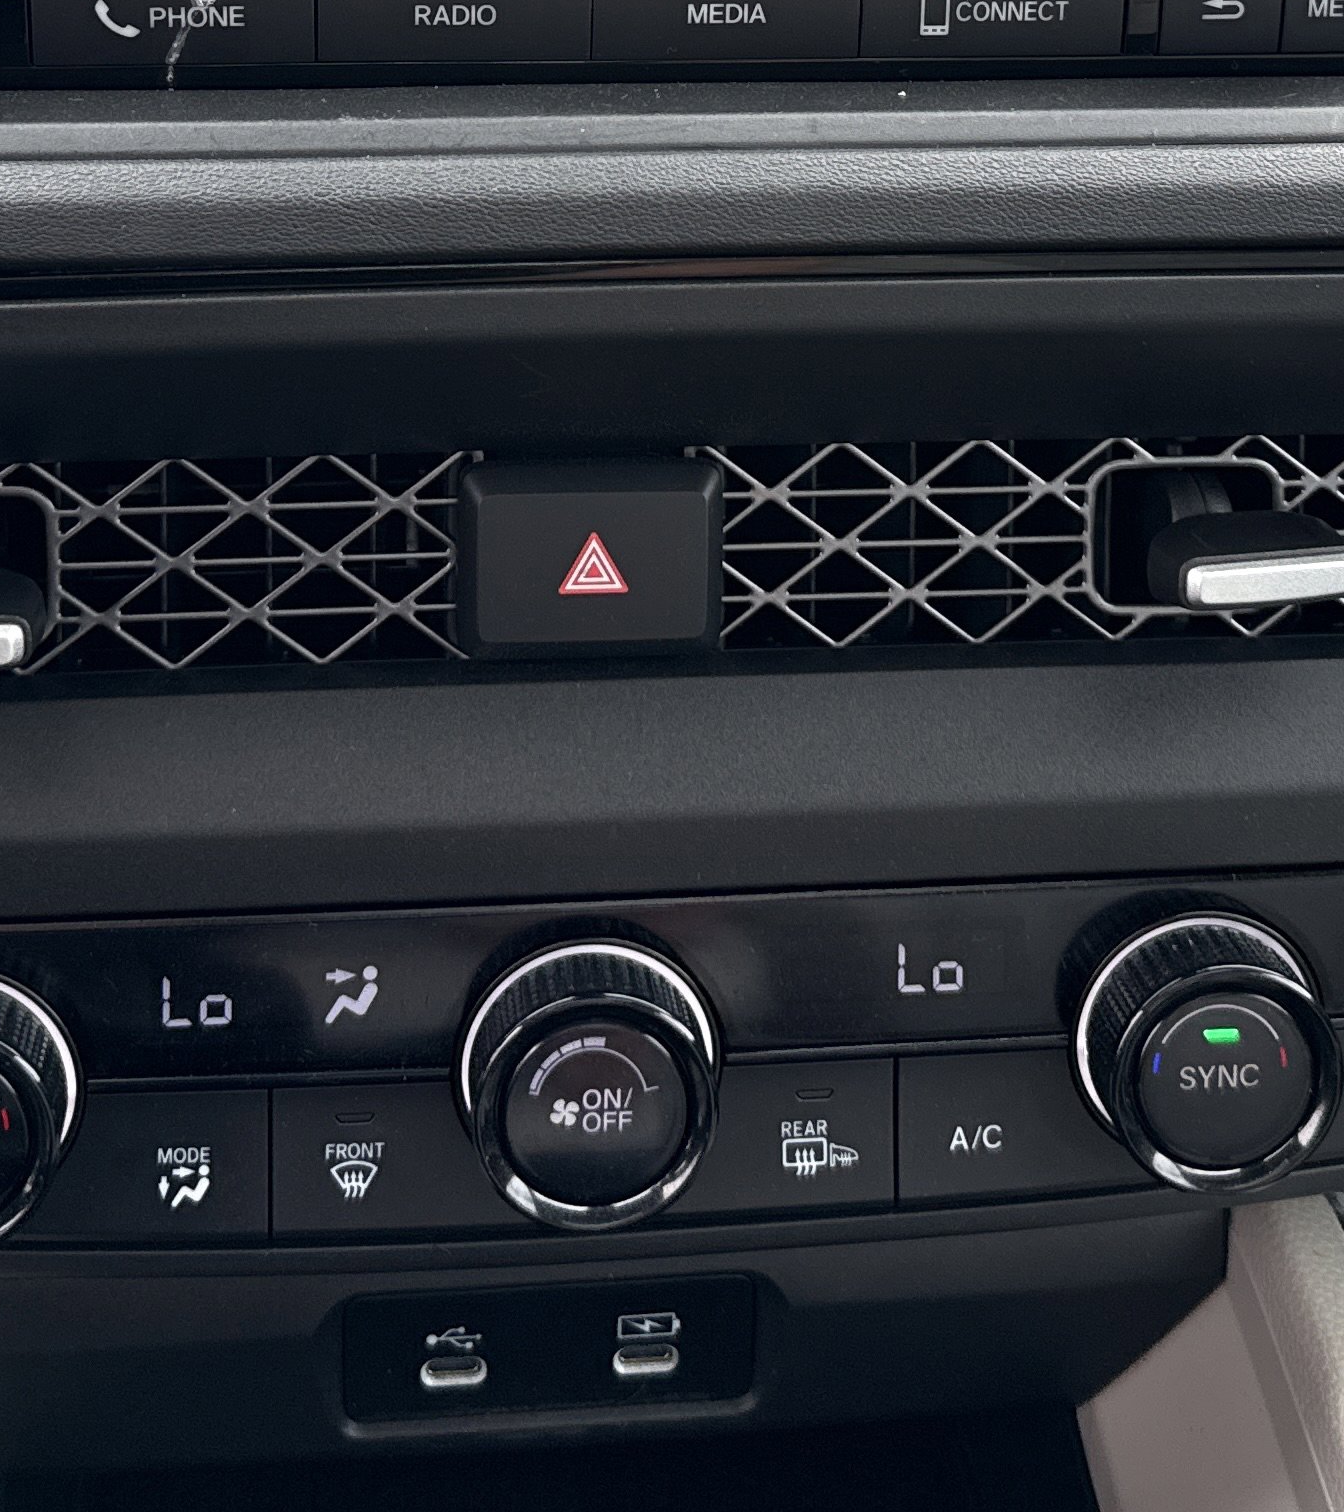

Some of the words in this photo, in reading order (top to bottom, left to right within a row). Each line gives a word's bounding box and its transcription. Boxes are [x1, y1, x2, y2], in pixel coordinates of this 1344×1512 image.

[149, 5, 245, 29] PHONE
[414, 4, 497, 26] RADIO
[687, 3, 766, 24] MEDIA
[955, 0, 1069, 22] CONNECT
[1179, 1063, 1259, 1090] SYNC
[582, 1110, 633, 1133] OFF
[781, 1119, 828, 1138] REAR
[949, 1124, 1002, 1151] A/C
[157, 1146, 210, 1164] MODE
[325, 1142, 385, 1160] FRONT
